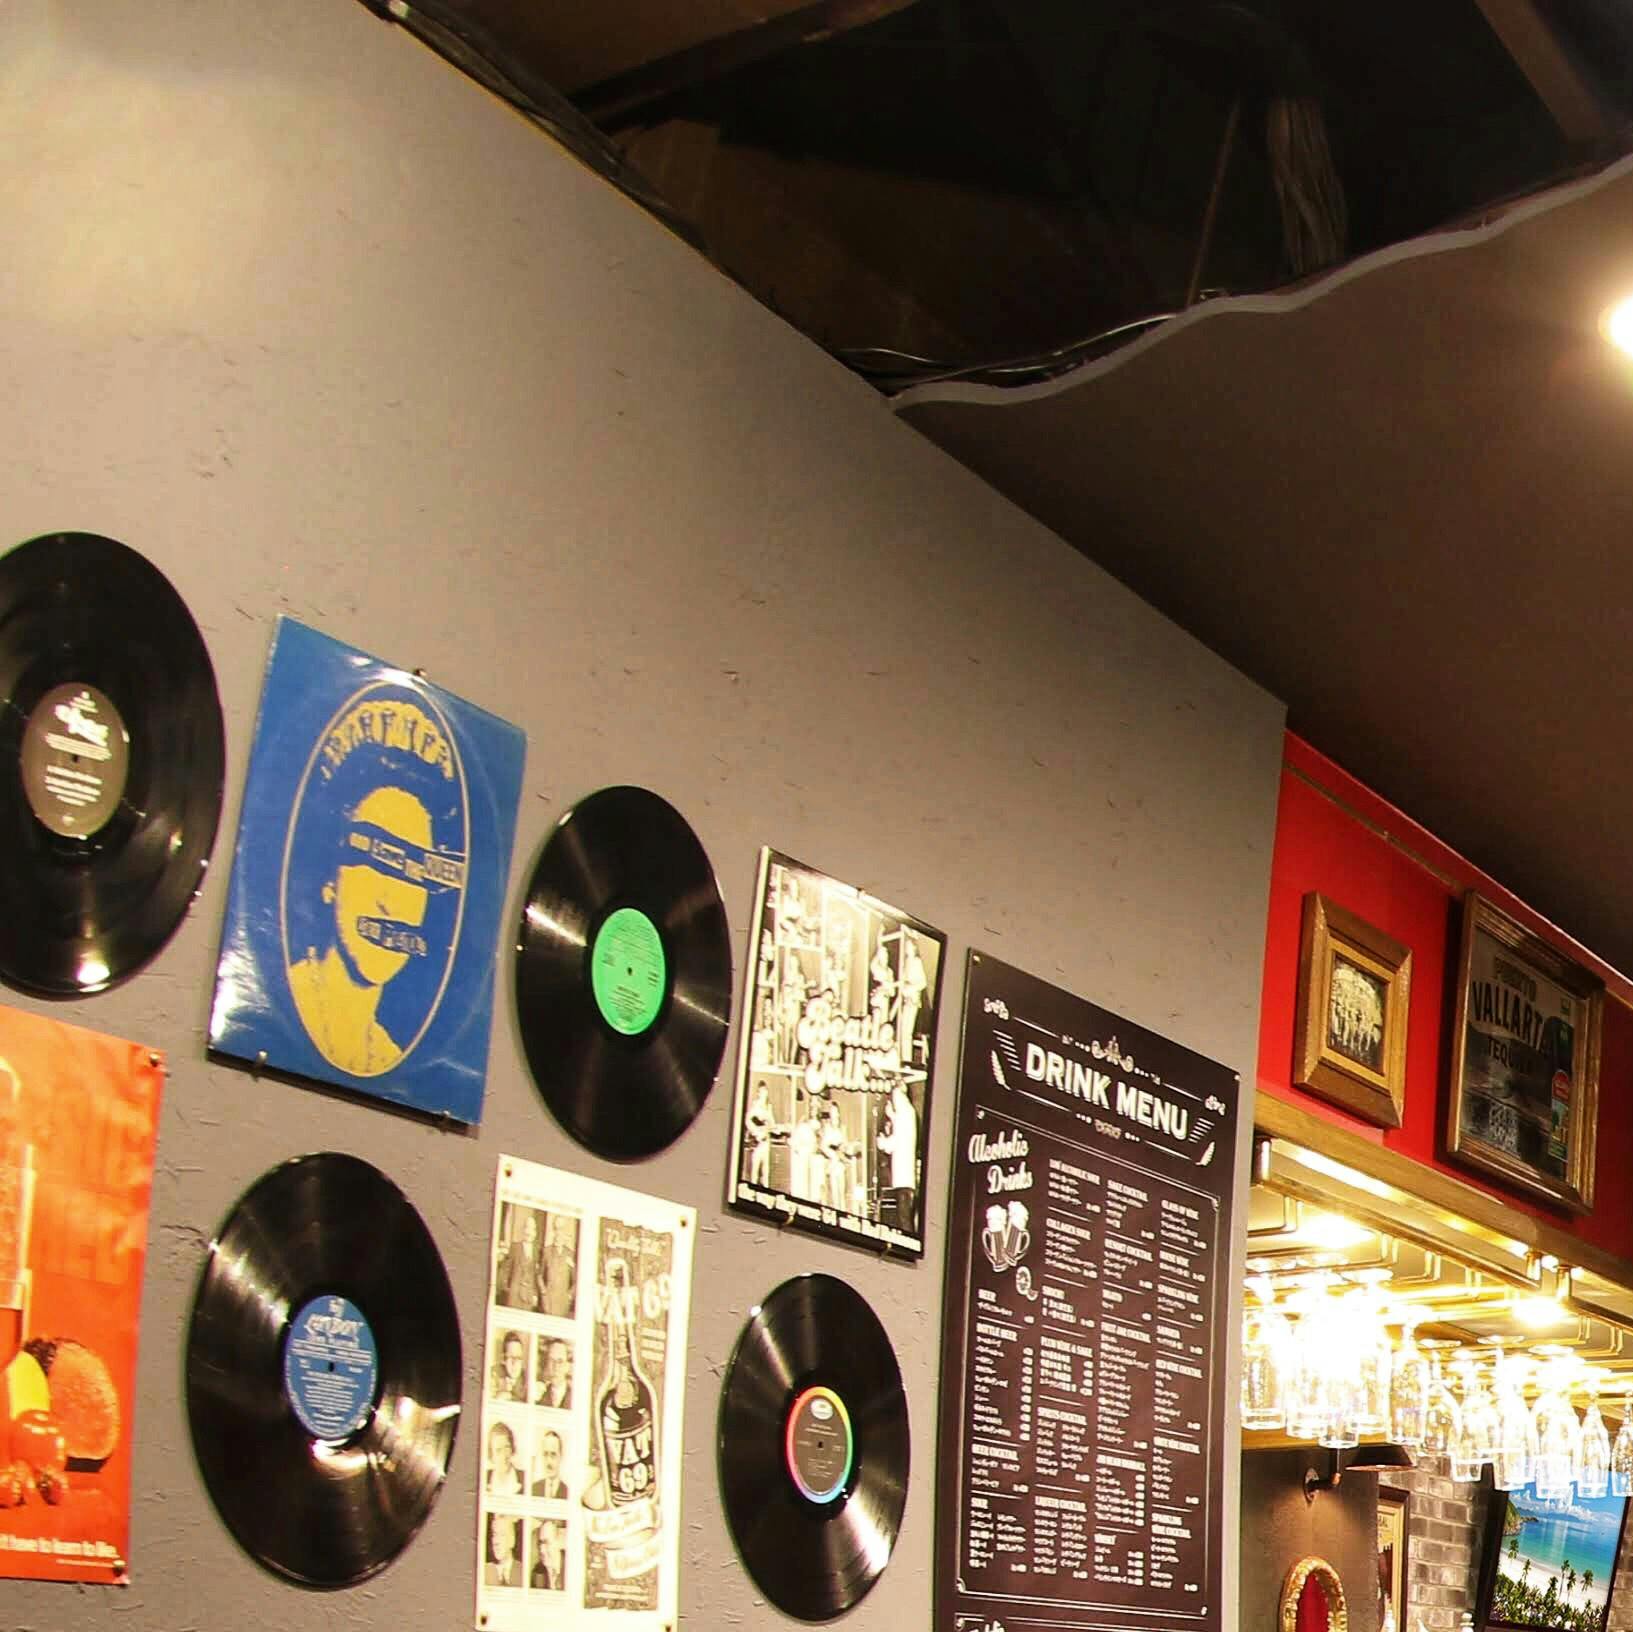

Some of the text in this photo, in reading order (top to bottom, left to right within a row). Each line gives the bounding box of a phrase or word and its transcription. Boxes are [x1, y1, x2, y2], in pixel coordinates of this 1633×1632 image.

[796, 993, 896, 1053] Beatle
[1025, 1043, 1189, 1140] DRINK MENU
[968, 1129, 1030, 1163] Alcoholic
[987, 1161, 1034, 1194] Drinks
[595, 1272, 673, 1326] VAT 69
[606, 1431, 651, 1466] VAT
[619, 1462, 649, 1494] 69
